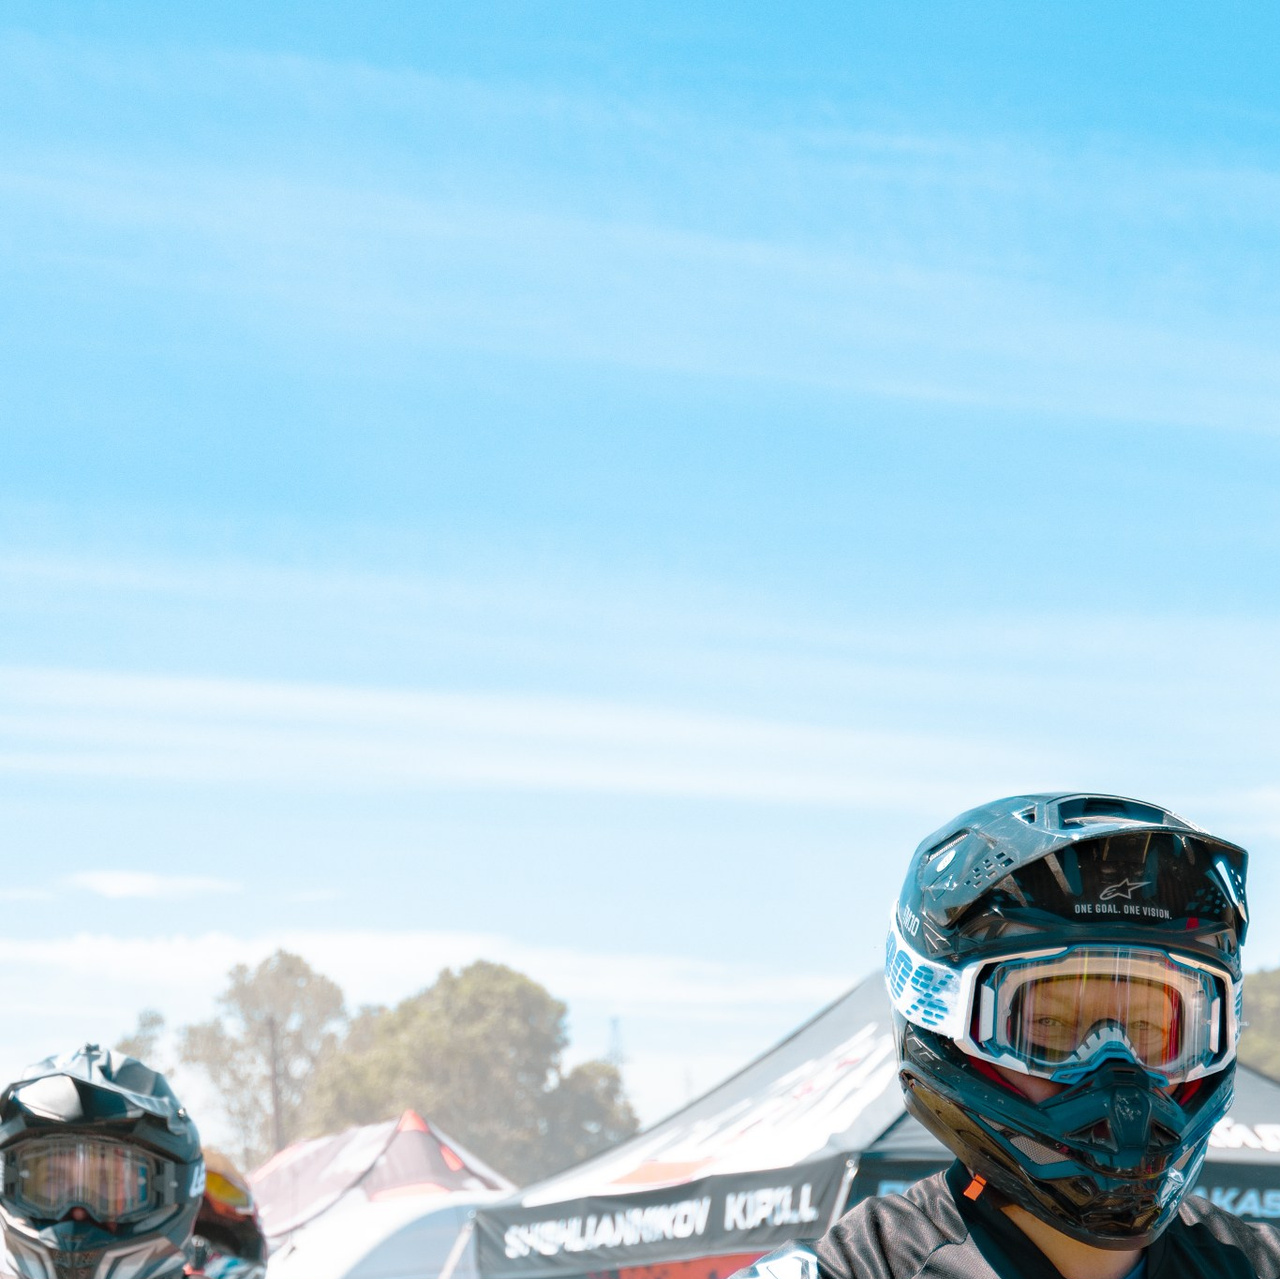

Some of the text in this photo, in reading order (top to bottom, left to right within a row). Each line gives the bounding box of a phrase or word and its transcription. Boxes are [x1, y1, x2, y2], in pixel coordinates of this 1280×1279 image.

[1074, 904, 1173, 920] ONE GOAL. ONE VISION.
